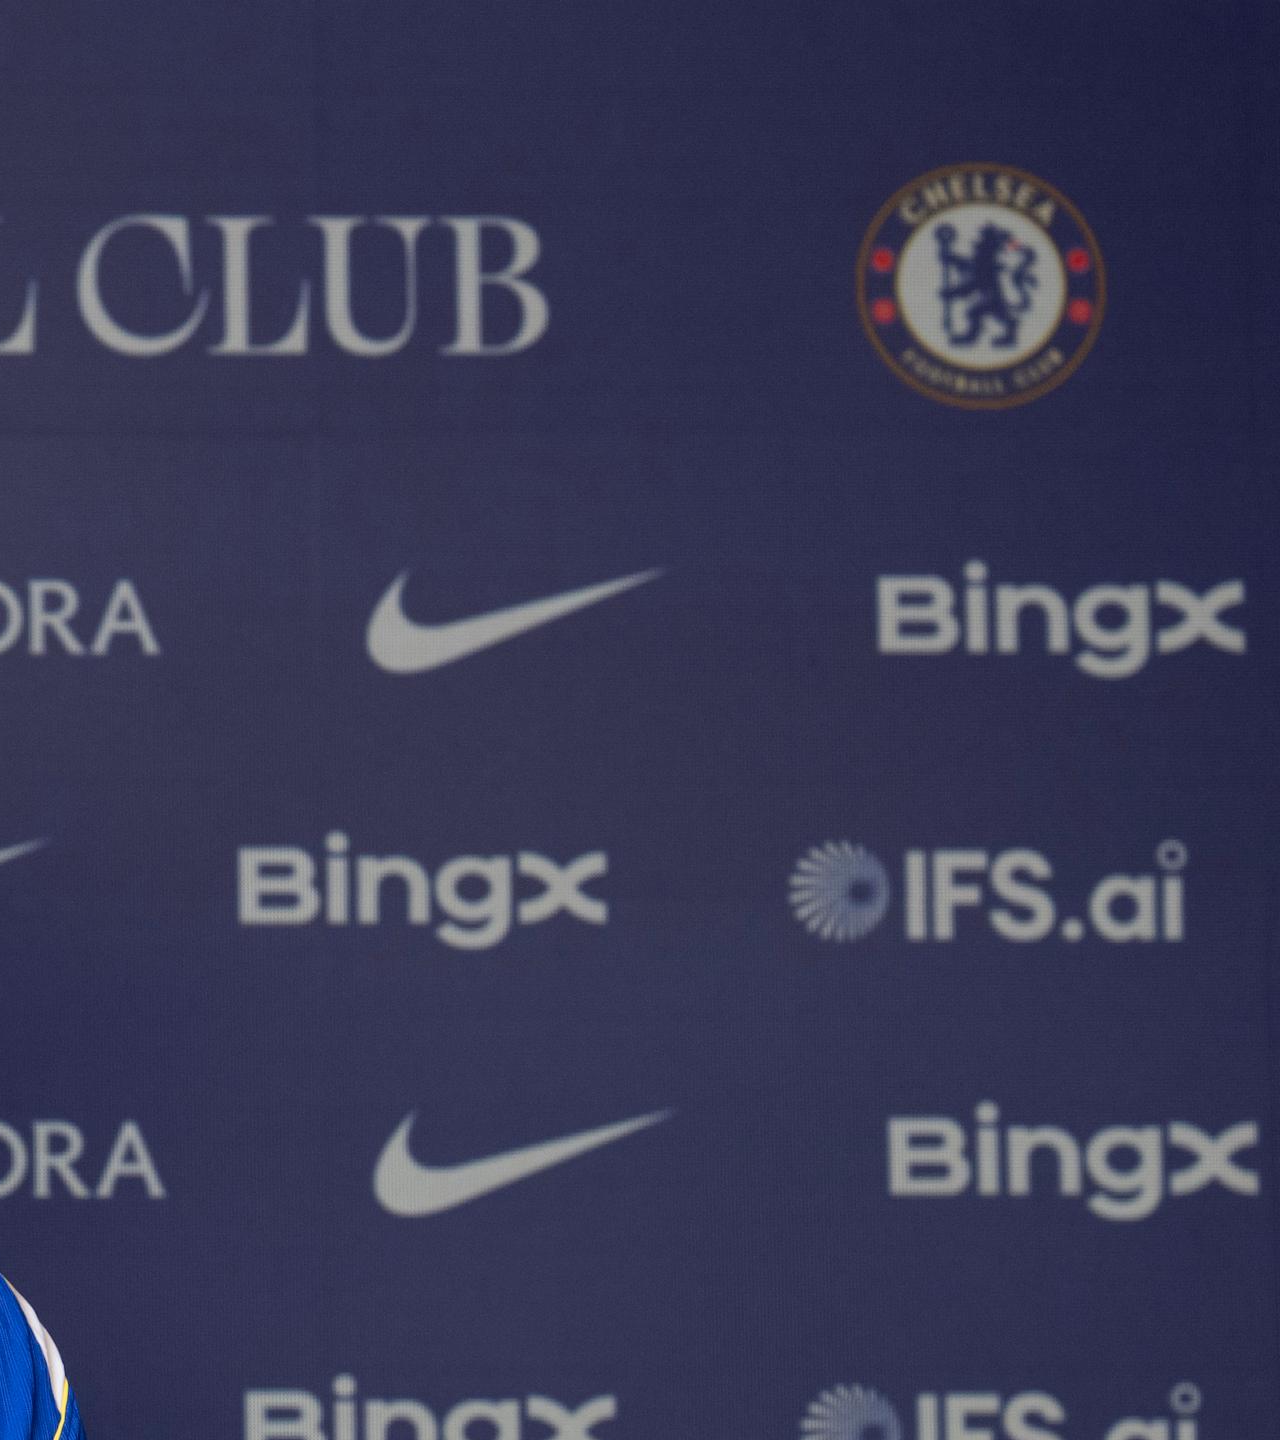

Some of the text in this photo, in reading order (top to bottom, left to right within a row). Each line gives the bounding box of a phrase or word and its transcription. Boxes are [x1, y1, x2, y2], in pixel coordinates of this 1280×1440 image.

[77, 214, 549, 357] CLUB
[876, 560, 1246, 679] Bingx
[237, 831, 608, 951] Bingx
[904, 840, 1187, 943] IFS.ai
[887, 1101, 1260, 1222] Bingx
